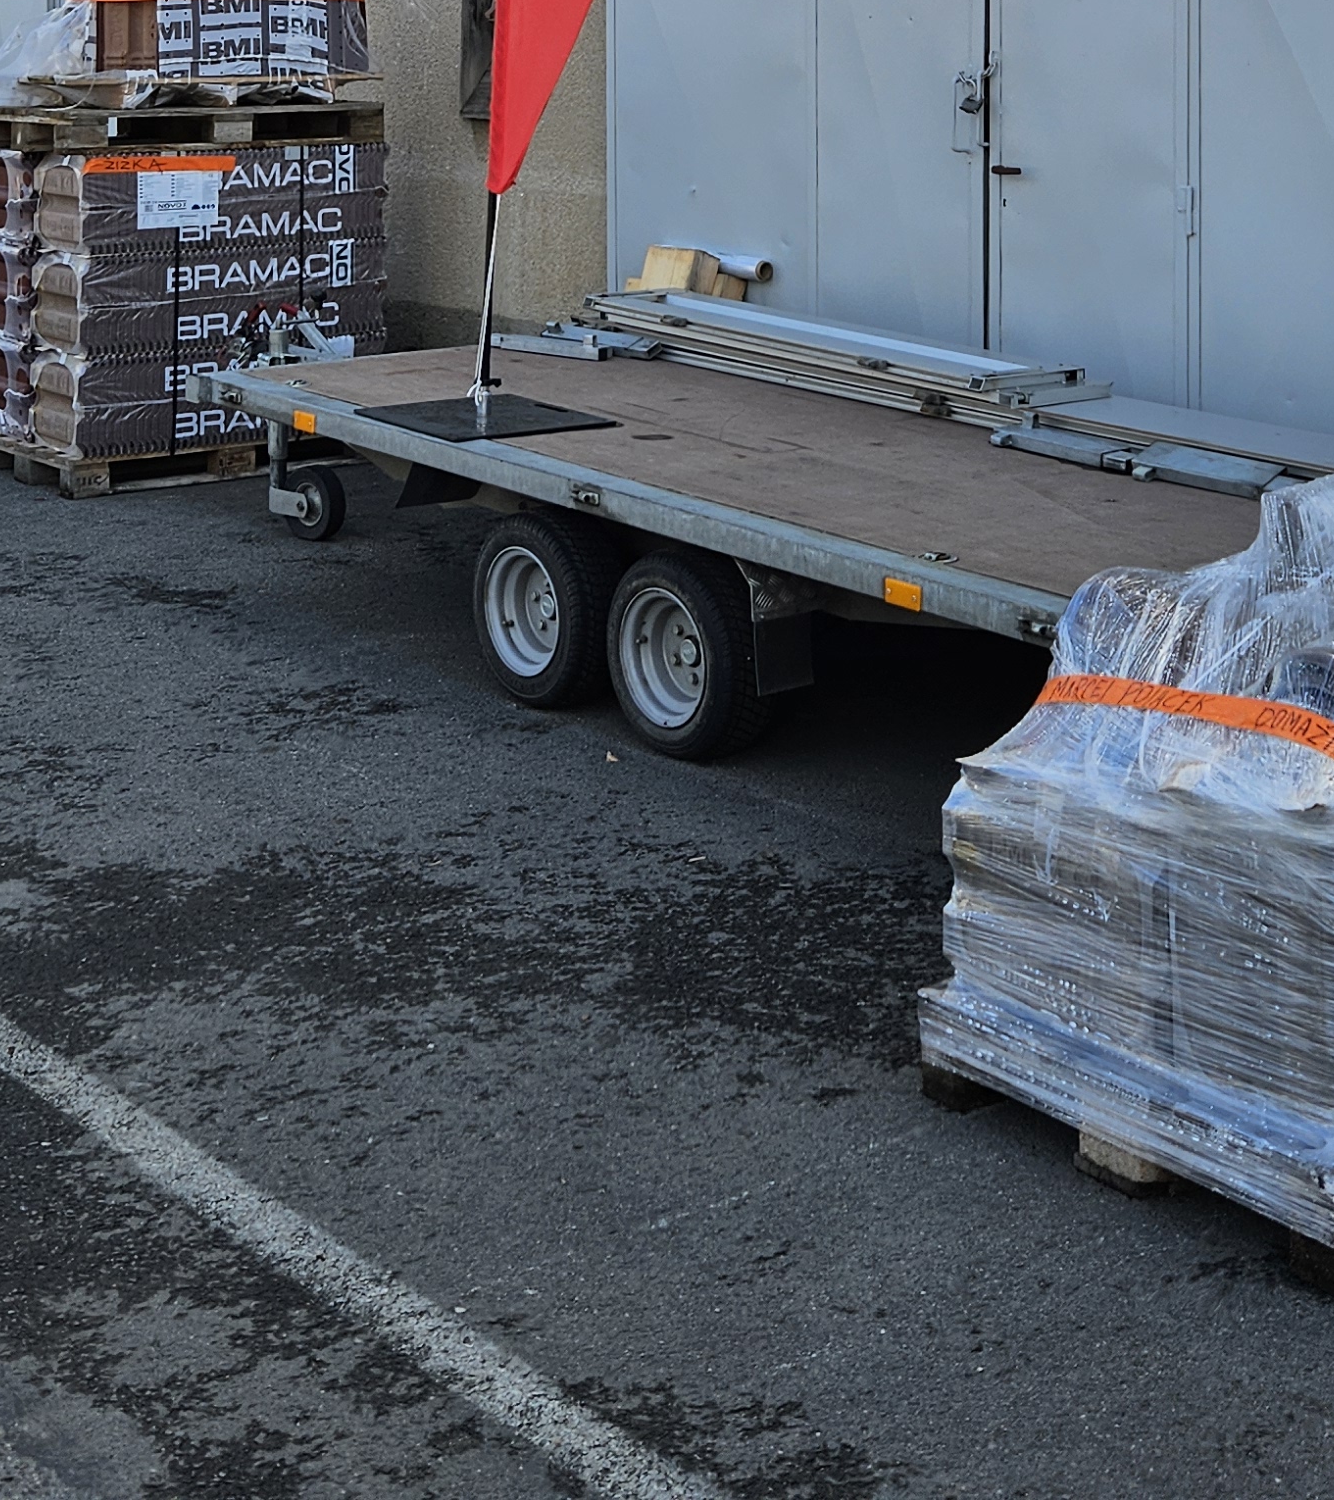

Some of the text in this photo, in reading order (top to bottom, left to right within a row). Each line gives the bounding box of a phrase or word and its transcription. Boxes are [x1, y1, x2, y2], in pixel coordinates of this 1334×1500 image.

[201, 37, 262, 65] BMI
[178, 207, 343, 242] BRAMAC
[166, 253, 331, 293] BRAMAC
